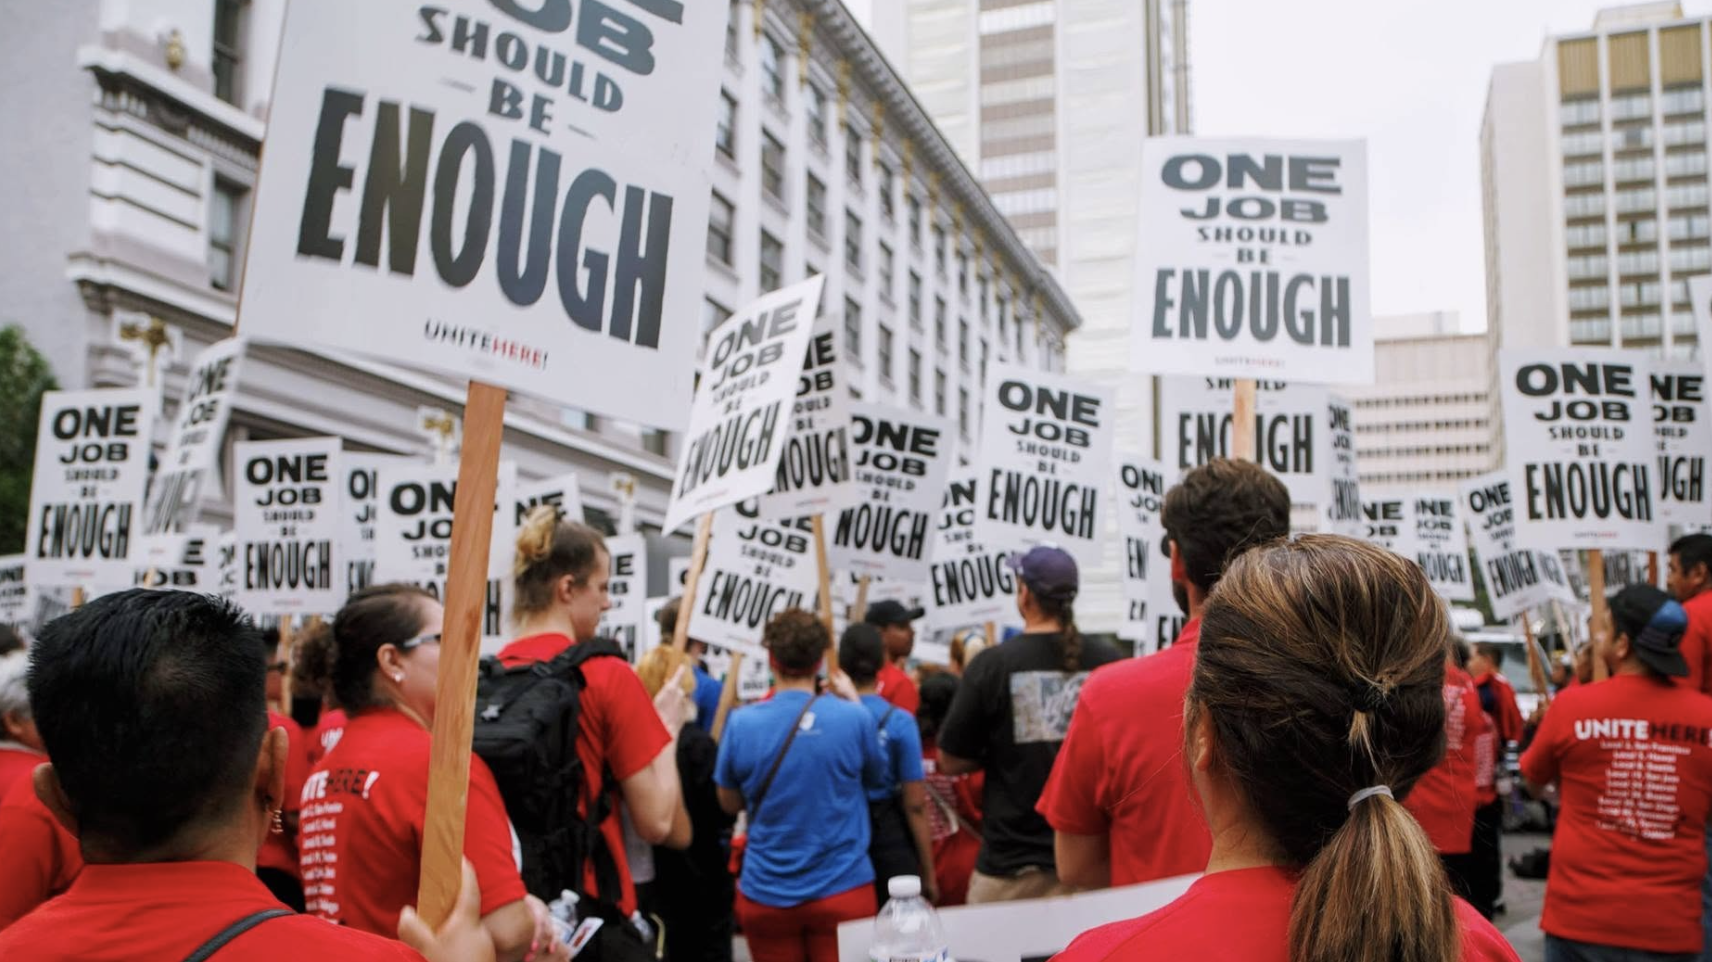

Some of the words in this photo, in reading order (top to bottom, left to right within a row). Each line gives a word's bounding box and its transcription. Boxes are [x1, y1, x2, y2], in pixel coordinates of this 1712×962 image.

[484, 0, 655, 76] OB
[415, 6, 624, 113] SHOULD
[487, 77, 555, 136] BE
[1161, 153, 1342, 195] ONE
[296, 85, 674, 351] ENOUGH
[1180, 196, 1329, 223] JOB
[1198, 227, 1313, 246] SHOULD
[1237, 247, 1273, 265] BE
[1152, 267, 1351, 348] ENOUGH
[424, 319, 548, 370] UNITEHERE!
[712, 298, 803, 371] ONE
[712, 342, 785, 390] JOB
[796, 370, 834, 396] OB
[1516, 363, 1637, 398] ONE
[794, 397, 831, 413] OULD
[998, 380, 1101, 427] ONE
[1650, 373, 1704, 402] NE
[52, 405, 141, 440] ONE
[1534, 400, 1631, 422] JOB
[1654, 405, 1696, 423] OB
[679, 400, 782, 500] ENOUGH
[852, 415, 940, 457] ONE
[1008, 418, 1091, 448] JOB
[1549, 426, 1624, 441] SHOULD
[59, 443, 129, 464] JOB
[768, 427, 849, 495] NOUGH
[855, 451, 927, 477] JOB
[1017, 440, 1081, 463] SHOULD
[246, 455, 329, 485] ONE
[1659, 456, 1704, 503] UGH
[256, 488, 322, 506] JOB
[390, 481, 457, 516] ON
[987, 468, 1097, 540] ENOUGH
[1131, 497, 1164, 513] JO
[1470, 482, 1511, 513] ONE
[1525, 462, 1653, 522] ENOUGH
[937, 509, 975, 530] JO
[1362, 501, 1404, 520] NE
[37, 503, 133, 559] ENOUGH
[402, 519, 453, 541] JO
[737, 524, 809, 553] JOB
[834, 503, 929, 560] NOUGH
[246, 540, 331, 590] ENOUGH
[931, 552, 1013, 607] ENOUG
